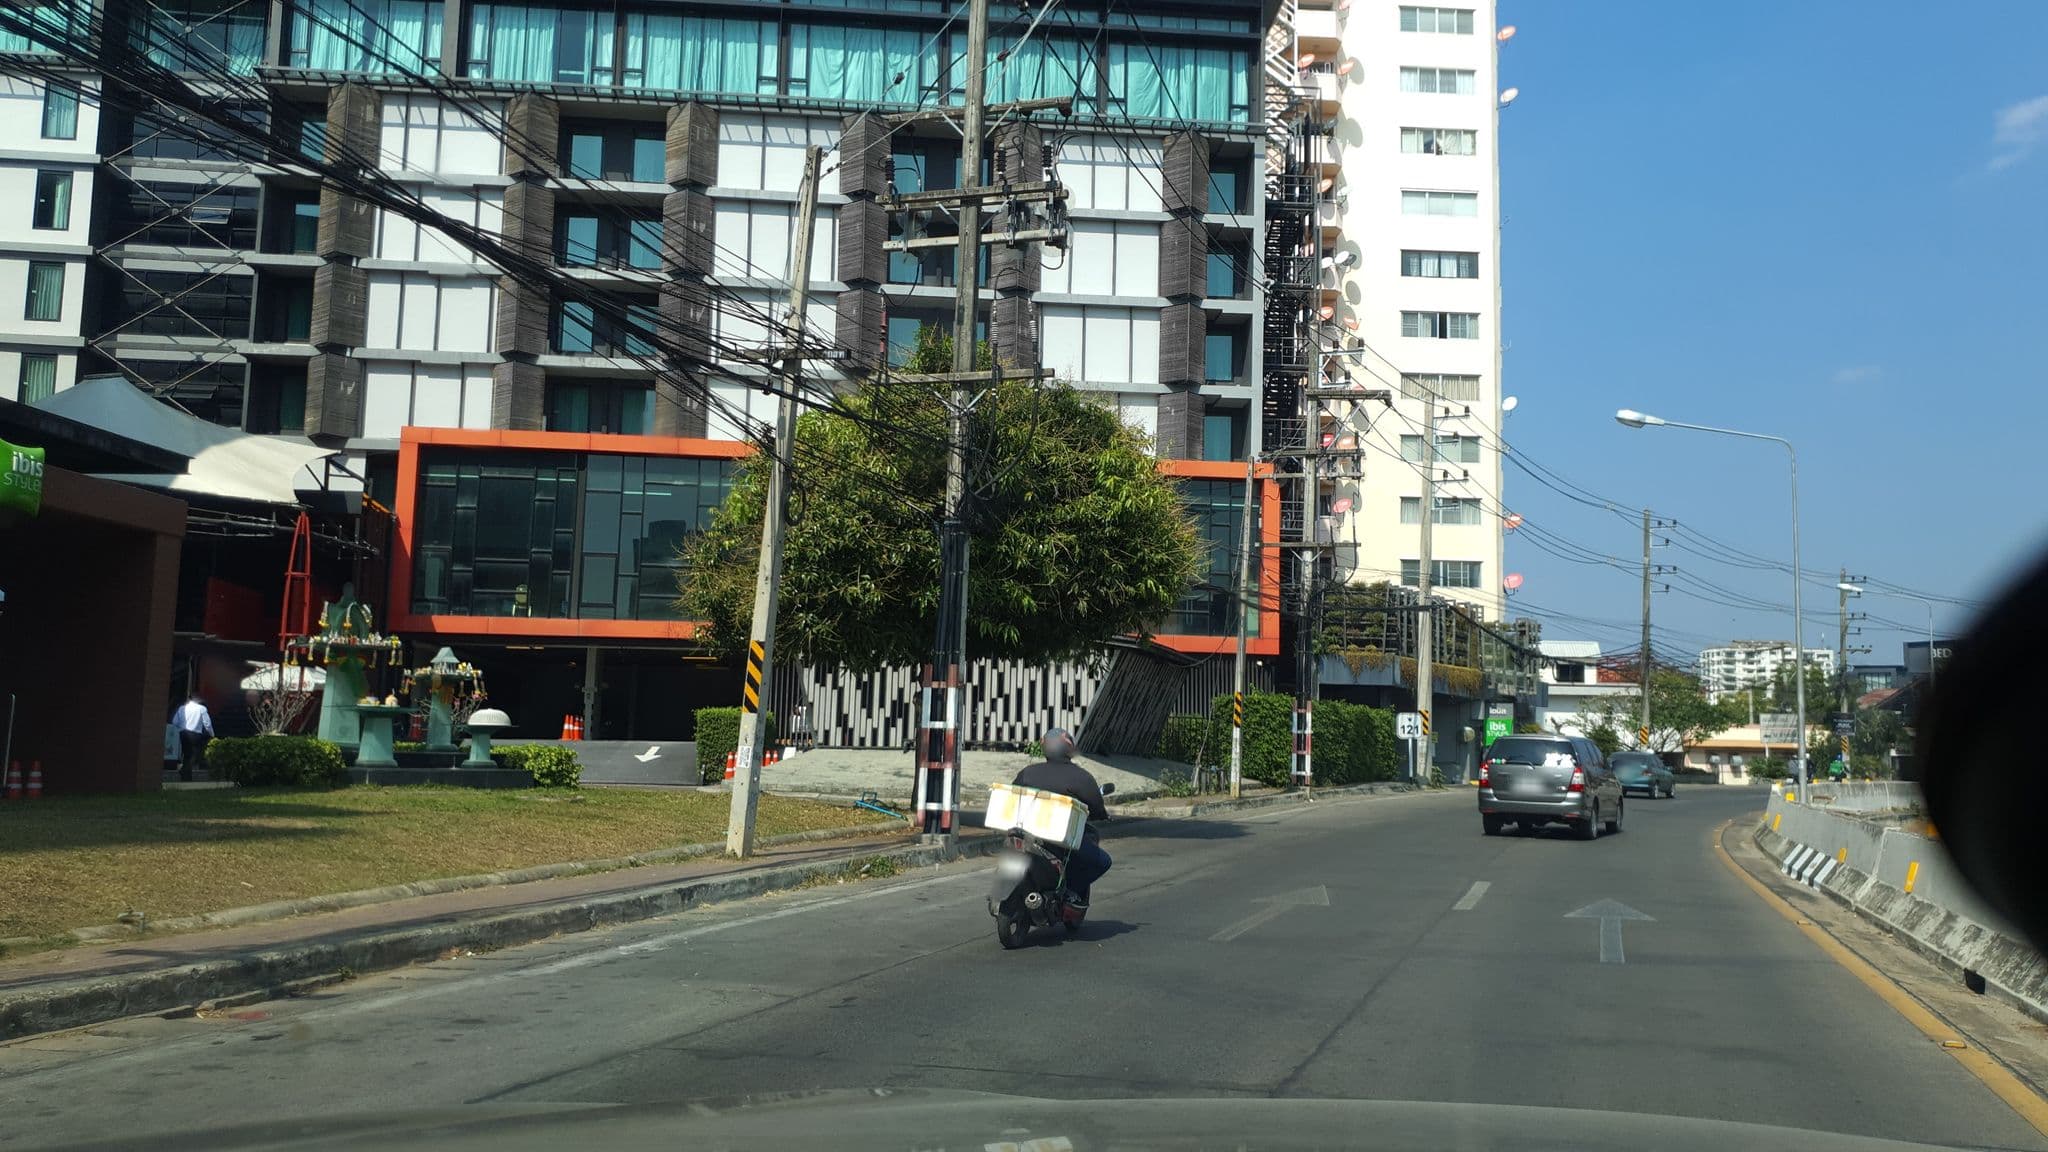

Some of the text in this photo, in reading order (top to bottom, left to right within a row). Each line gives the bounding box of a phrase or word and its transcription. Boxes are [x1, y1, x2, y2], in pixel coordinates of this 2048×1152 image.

[12, 451, 44, 477] ibis
[3, 472, 42, 493] STYLE
[1400, 724, 1419, 735] 121
[1489, 720, 1507, 731] ibis
